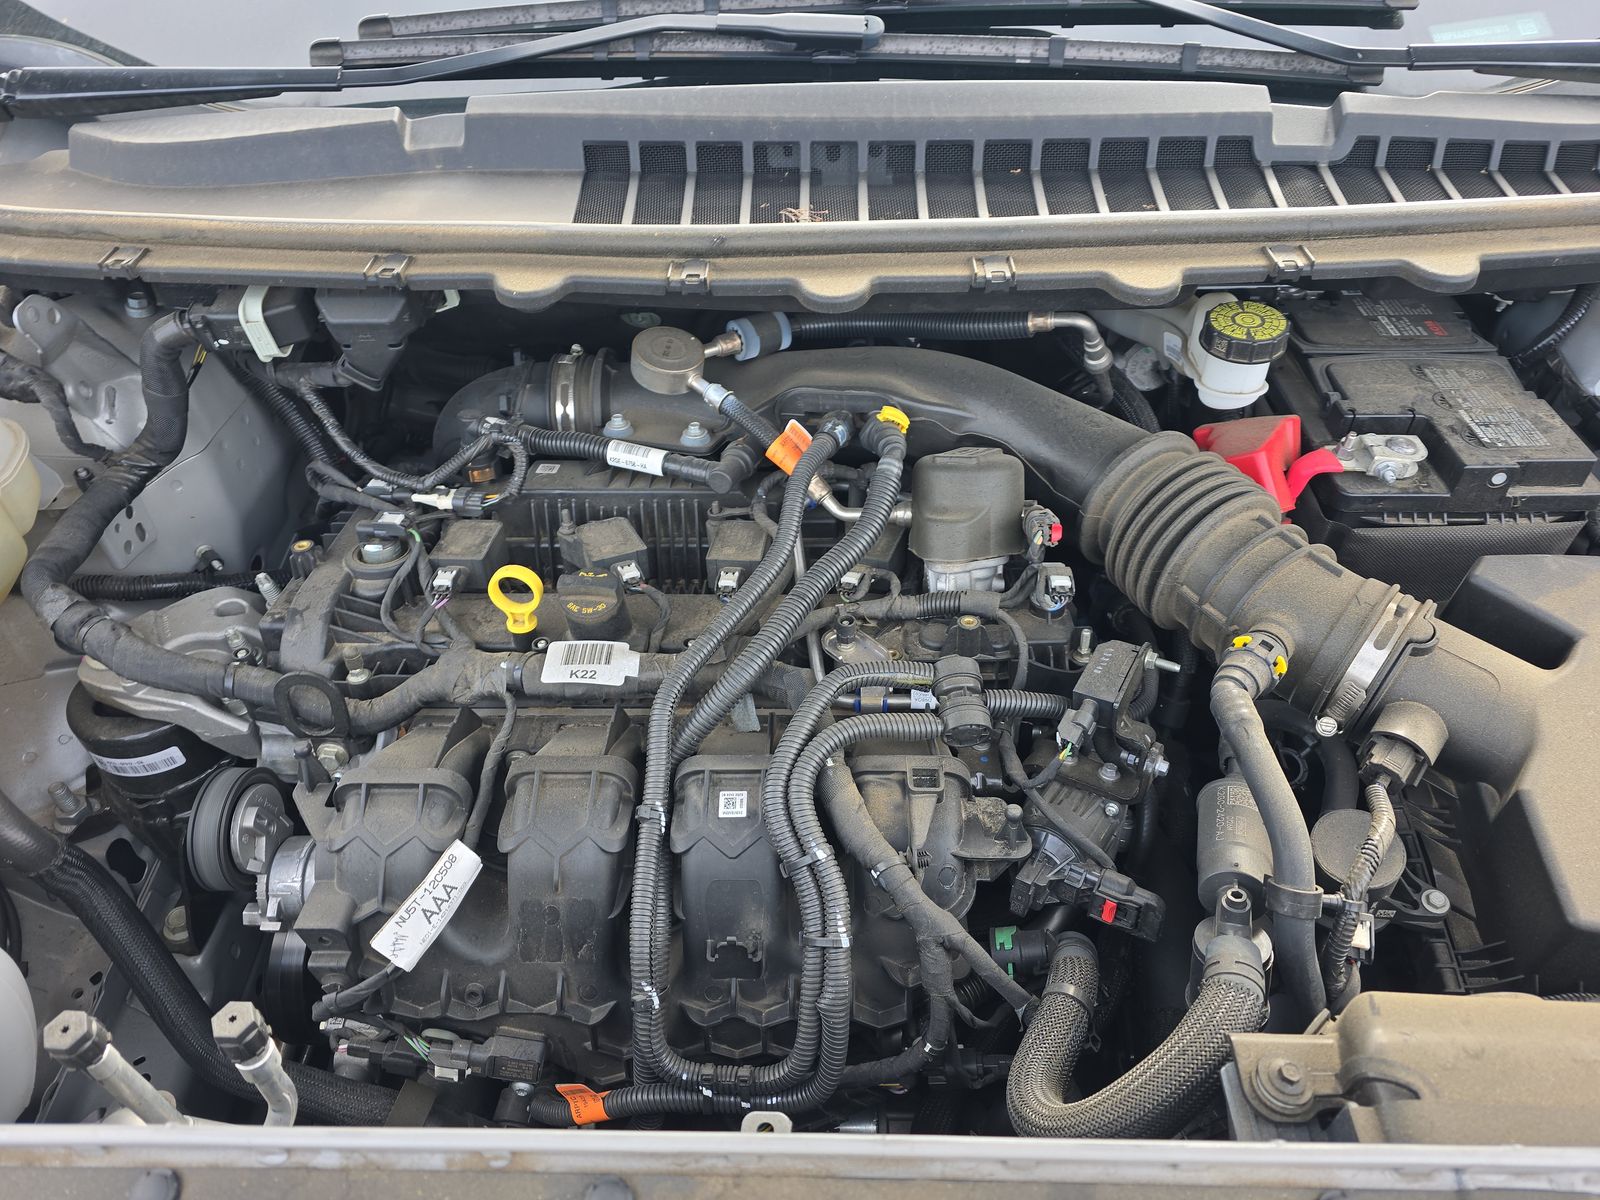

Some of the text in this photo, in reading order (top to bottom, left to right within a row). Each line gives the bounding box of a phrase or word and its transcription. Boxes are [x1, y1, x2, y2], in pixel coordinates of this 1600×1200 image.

[569, 669, 597, 680] K22
[394, 853, 458, 929] NU5T-12C508
[420, 883, 459, 925] AAA
